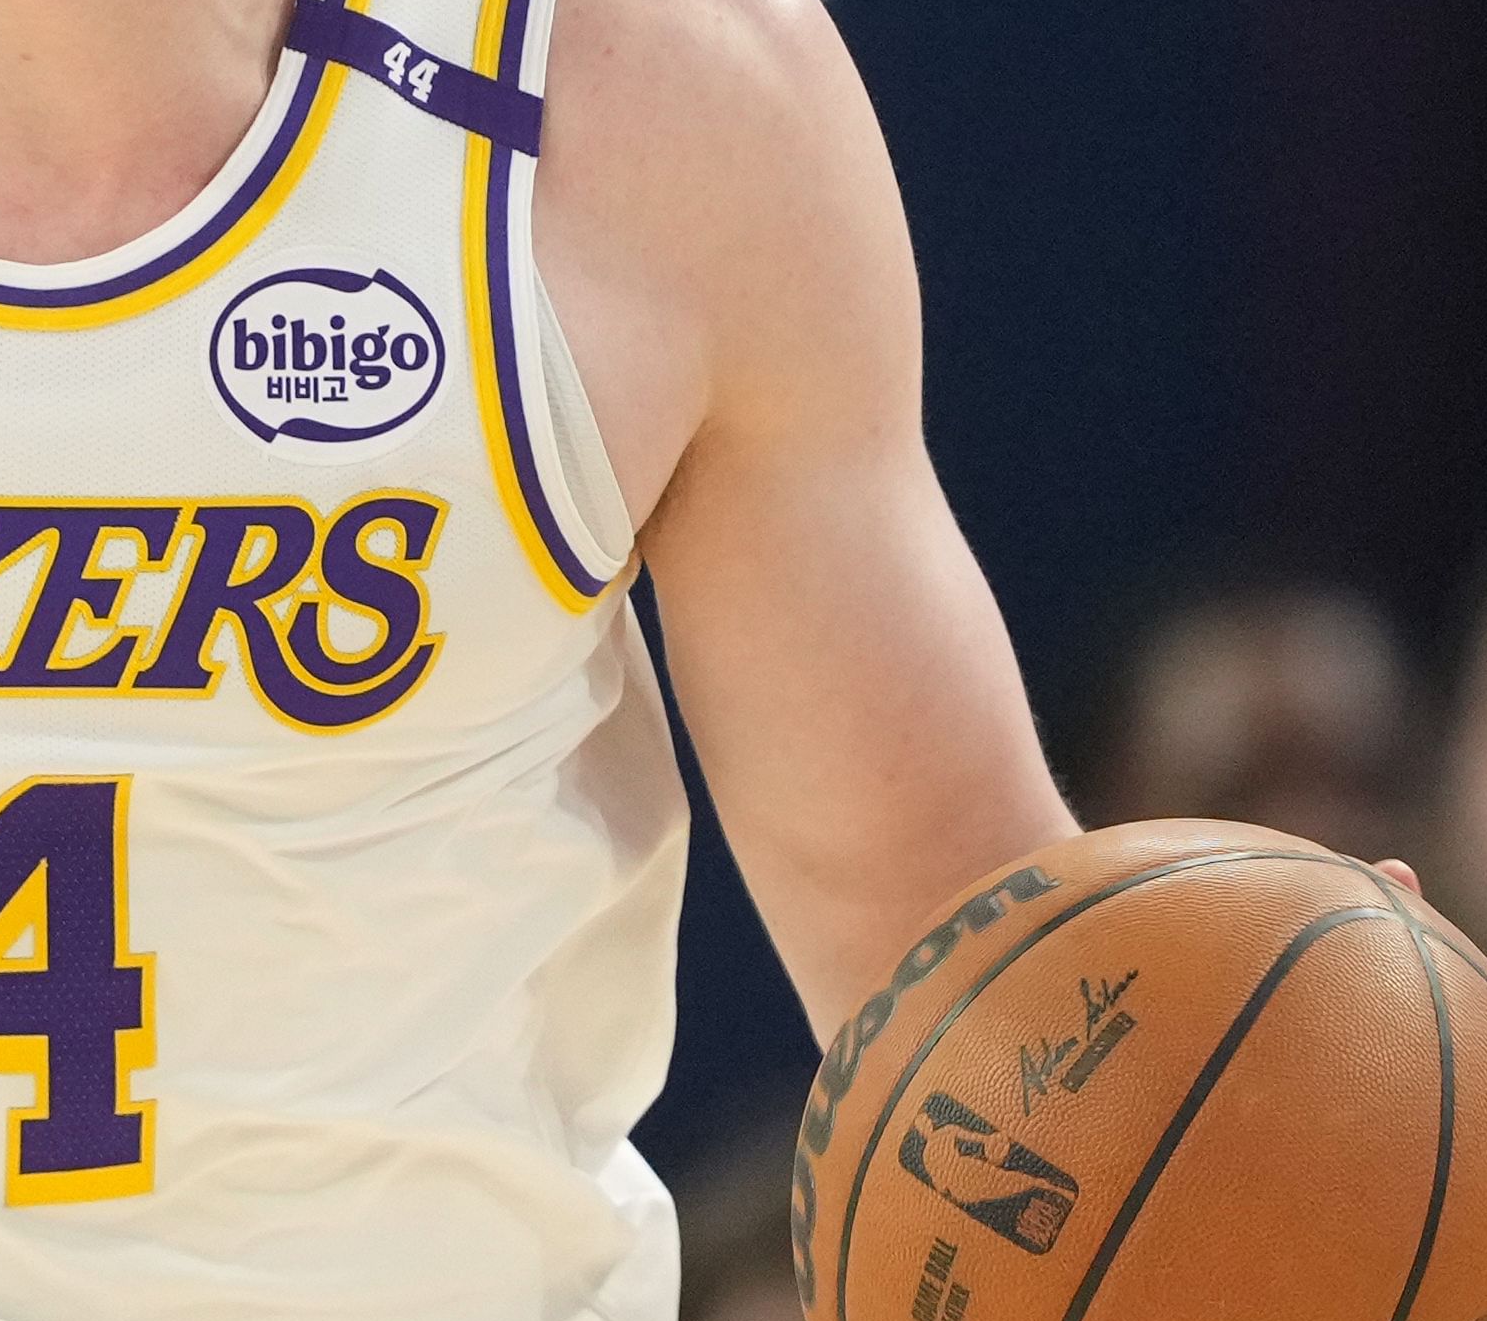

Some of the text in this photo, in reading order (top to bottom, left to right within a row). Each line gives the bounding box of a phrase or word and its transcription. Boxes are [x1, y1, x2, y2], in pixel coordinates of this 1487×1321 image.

[383, 41, 440, 102] 44
[232, 314, 430, 390] bibigo
[266, 376, 349, 404] 비비고
